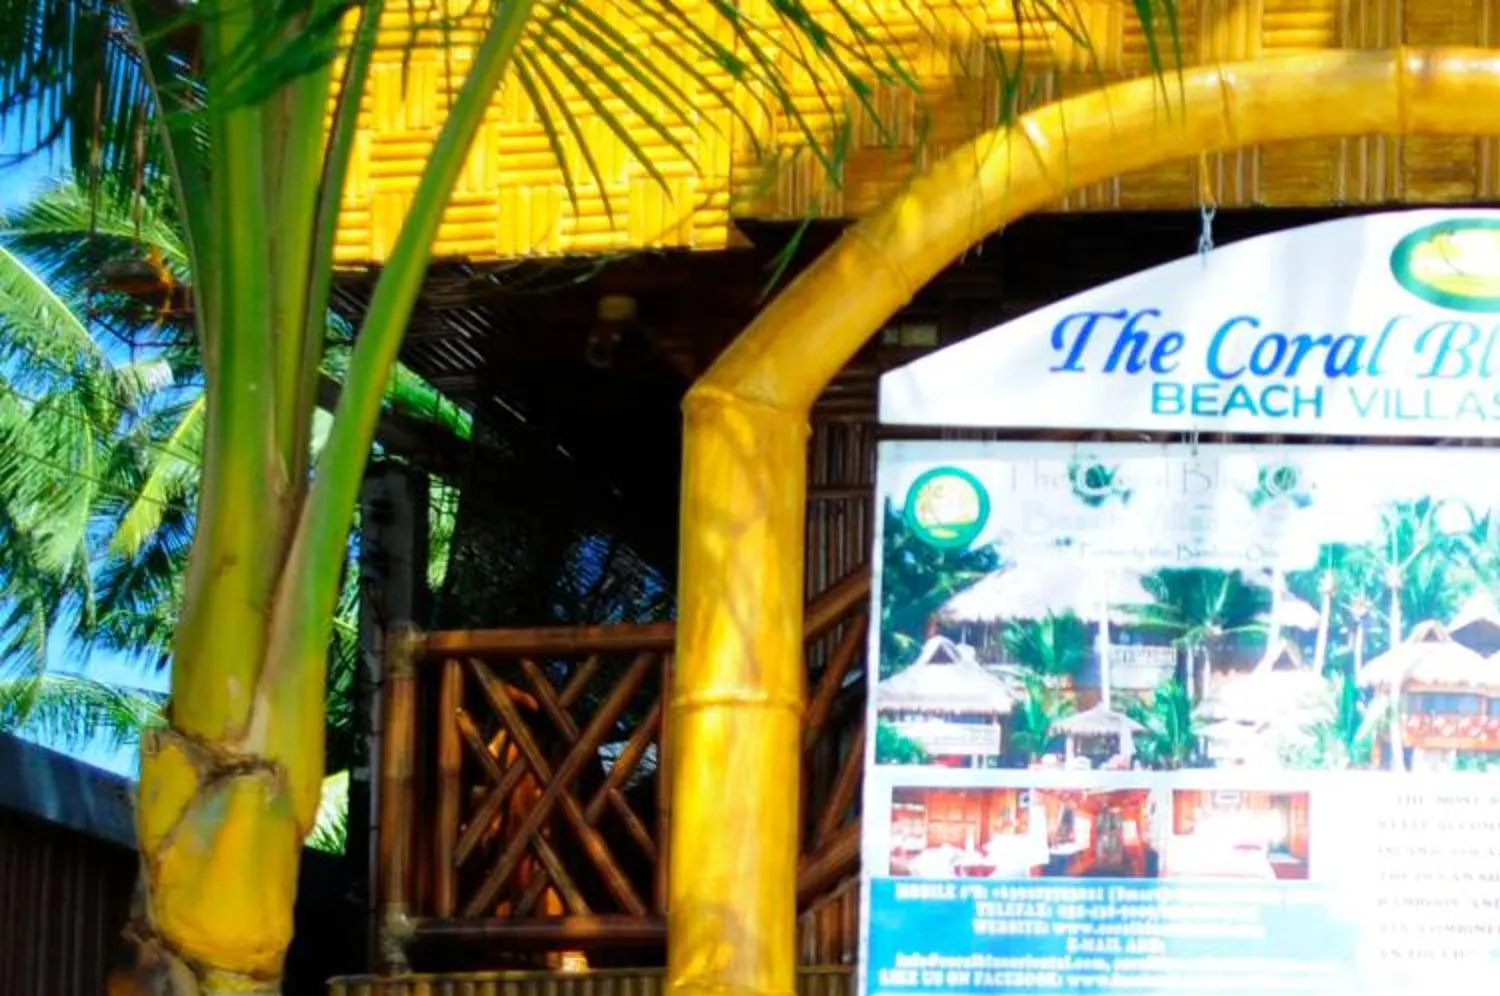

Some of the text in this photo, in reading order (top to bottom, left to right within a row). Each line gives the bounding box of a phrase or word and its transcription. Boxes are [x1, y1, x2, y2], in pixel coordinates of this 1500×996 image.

[1050, 308, 1185, 373] The
[1206, 314, 1402, 379] Coral
[1151, 382, 1322, 419] BEACH
[880, 970, 919, 985] LIKE
[923, 970, 943, 986] US
[947, 970, 971, 986] ON
